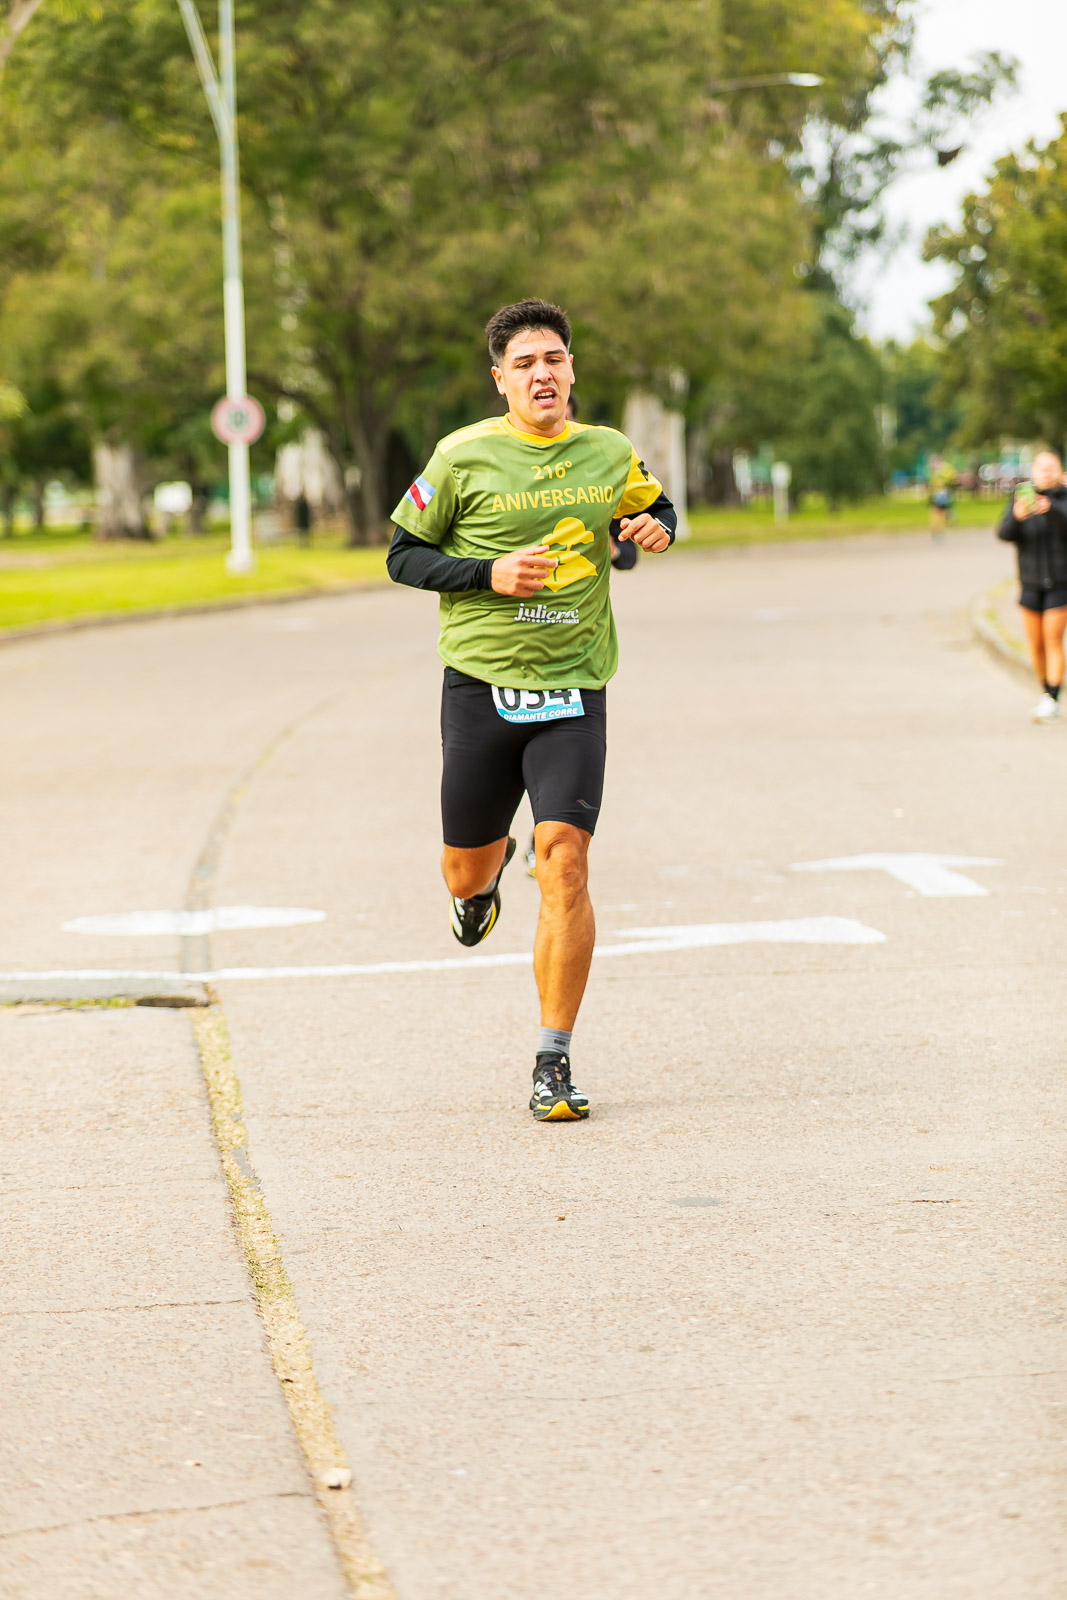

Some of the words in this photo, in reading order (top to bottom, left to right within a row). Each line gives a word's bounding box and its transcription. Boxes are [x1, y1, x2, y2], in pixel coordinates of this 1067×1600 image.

[491, 485, 614, 513] ANIVERSARIO
[503, 711, 547, 721] DIAMANTE
[548, 707, 578, 718] CORRE
